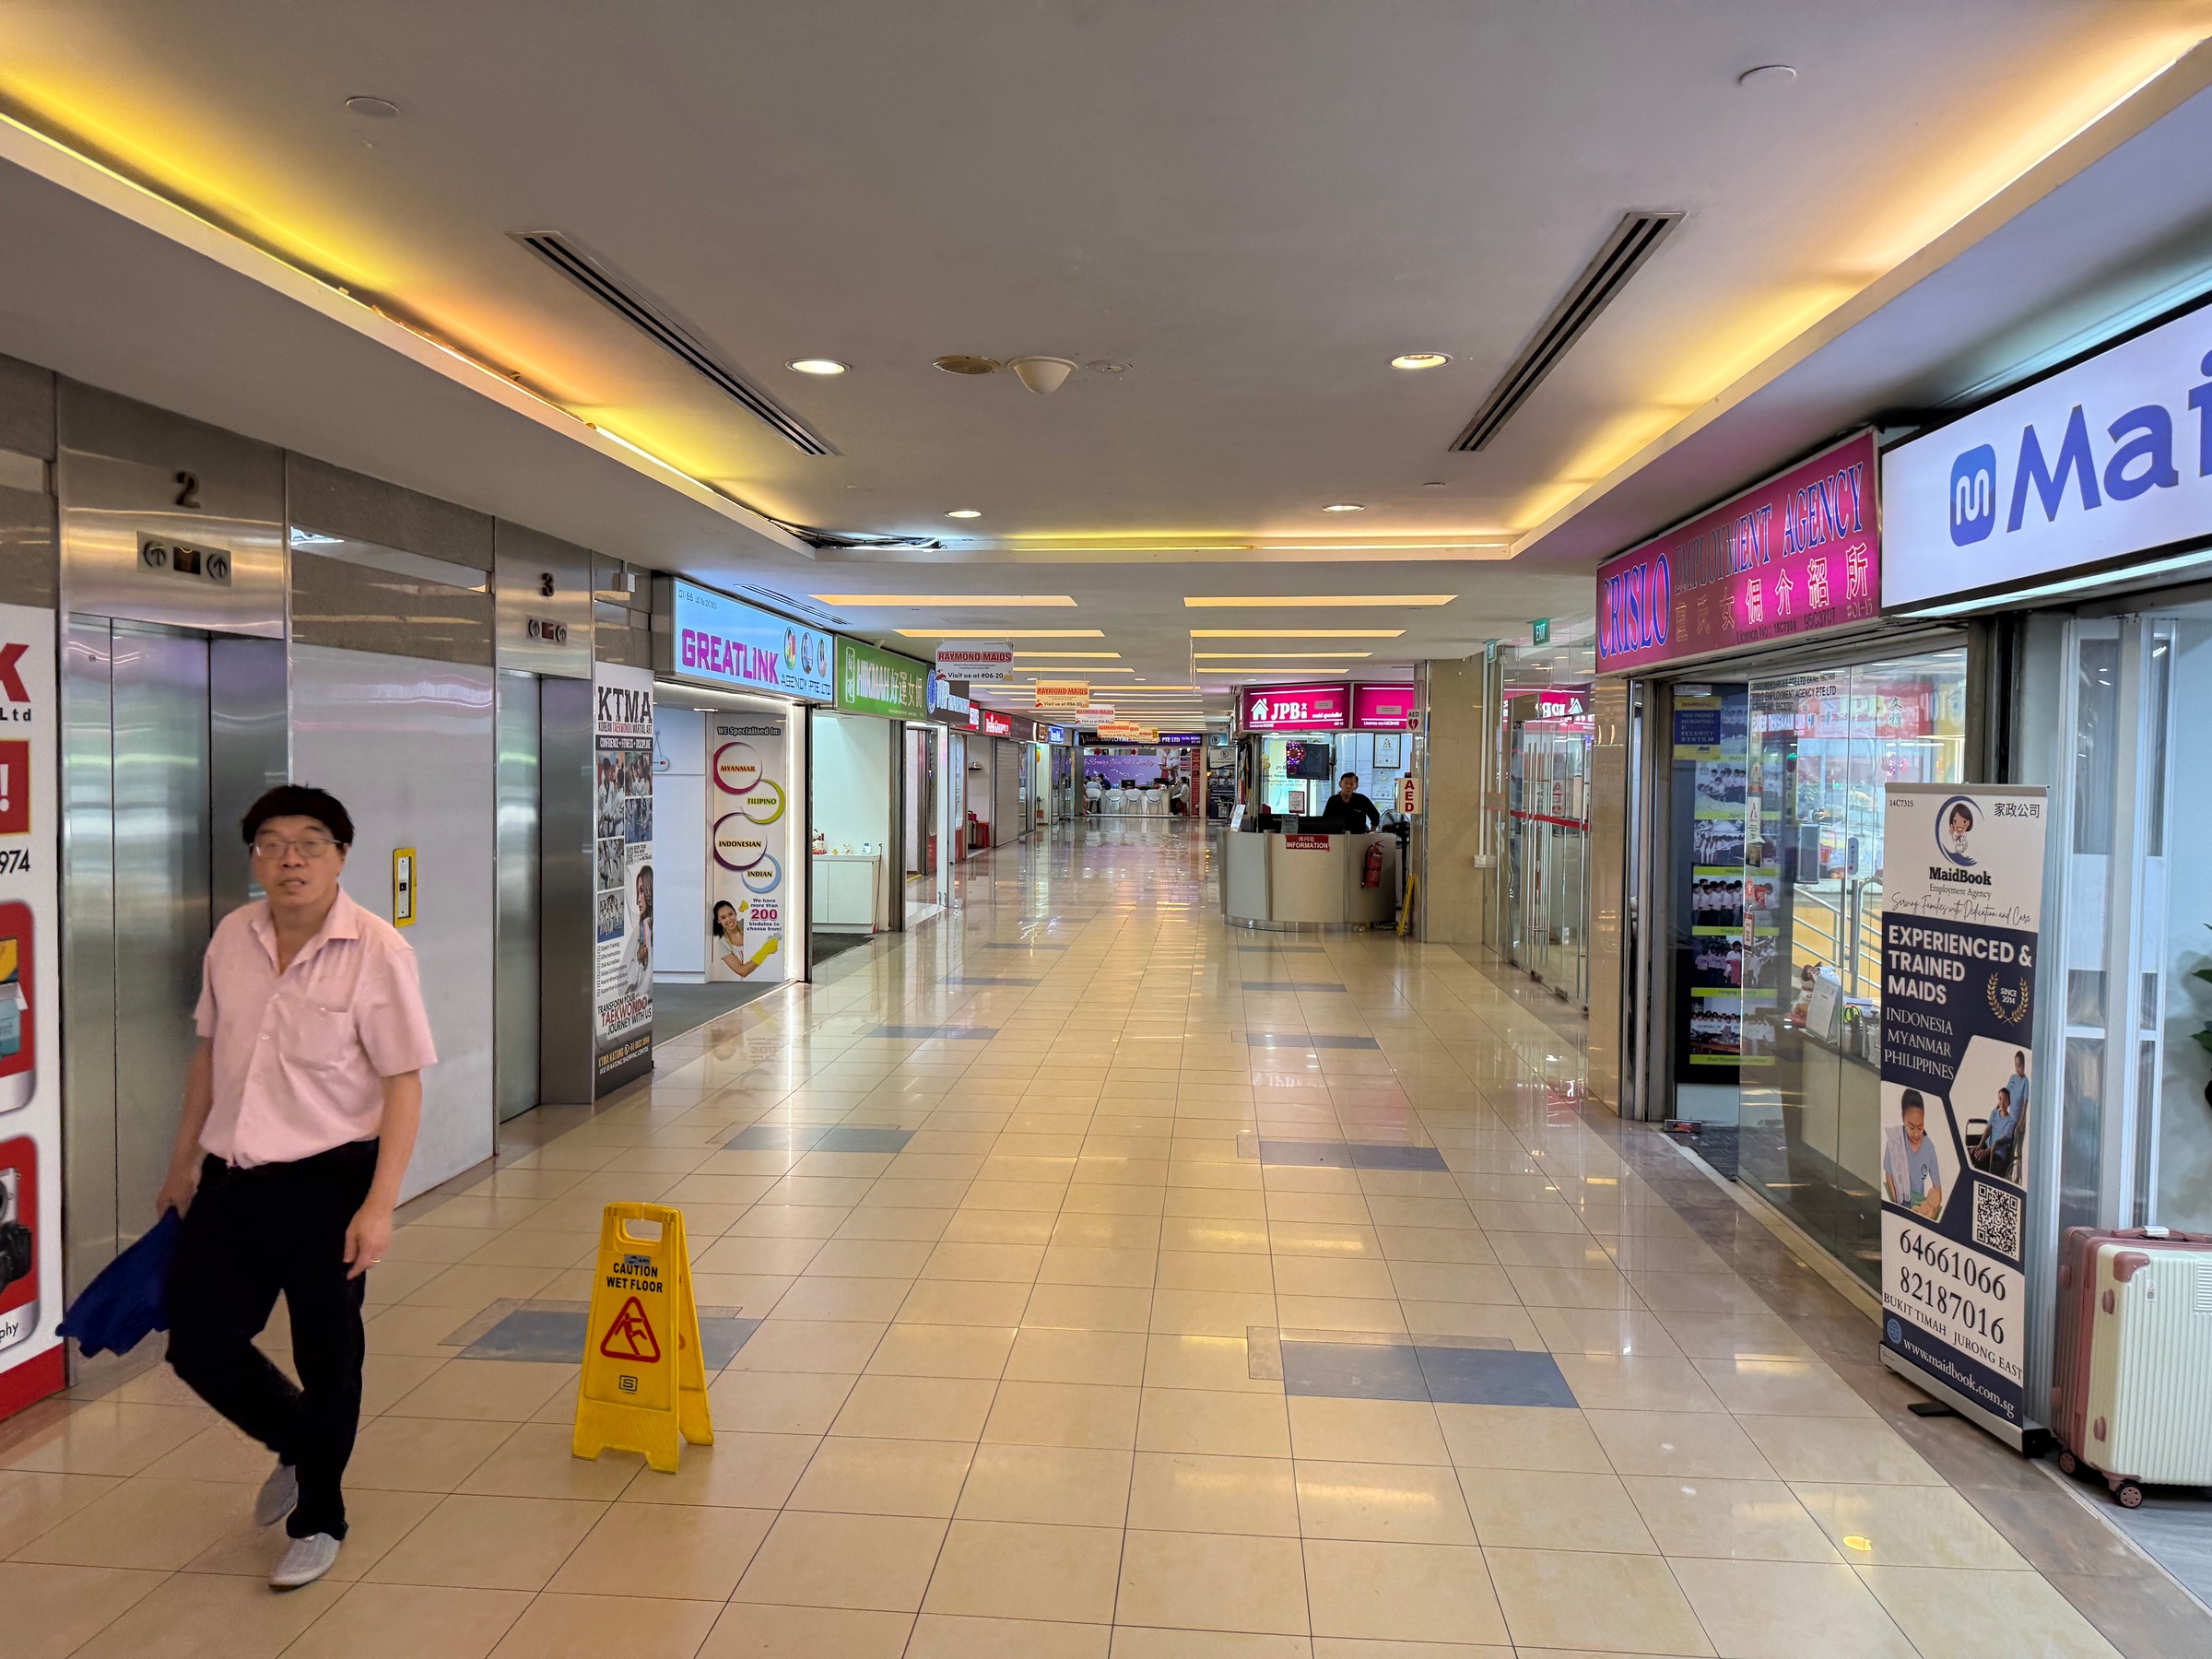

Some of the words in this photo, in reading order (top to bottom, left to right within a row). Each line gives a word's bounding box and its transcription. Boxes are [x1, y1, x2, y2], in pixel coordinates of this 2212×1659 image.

[174, 471, 202, 510] 2
[1598, 552, 1671, 660] CRISLO
[1674, 503, 1771, 596] EMPLOYMENT
[1783, 462, 1864, 558] AGENCY
[540, 572, 555, 597] 3
[682, 628, 780, 685] GREATLINK
[937, 652, 981, 663] RAYMOND
[982, 652, 1012, 663] MAIDS
[781, 674, 807, 690] AGENCY
[808, 680, 820, 693] PTE
[820, 683, 831, 696] LTD
[1795, 688, 1815, 699] AGENCY
[597, 686, 653, 724] KTMA
[1271, 701, 1301, 720] JPB
[600, 737, 618, 747] CONFIDENCE
[636, 739, 651, 749] DISCIPLINE
[717, 726, 728, 735] WE
[729, 726, 770, 736] Specialised
[1404, 780, 1415, 813] AED
[1889, 799, 1914, 807] 14C7315
[1994, 802, 2041, 818] 家政公司
[1929, 866, 1992, 886] MaidBook
[1929, 884, 1966, 897] Employment
[1968, 888, 1992, 900] Agency
[751, 909, 778, 920] 200
[1891, 891, 1920, 911] Serving
[1921, 894, 1947, 915] Families
[1963, 900, 1998, 924] Dedication
[1998, 906, 2012, 925] and
[2012, 906, 2032, 926] Care
[1888, 924, 2016, 963] EXPERIENCED
[2018, 945, 2033, 968] &
[1888, 950, 1966, 982] TRAINED
[597, 997, 624, 1014] TRANSFORM
[624, 993, 636, 1004] YOUR
[1888, 975, 1947, 1005] MAIDS
[2000, 987, 2018, 997] SINCE
[2001, 995, 2017, 1005] 2014
[601, 996, 649, 1028] TAEKWONDO
[607, 1017, 630, 1035] JOURNEY
[631, 1012, 645, 1025] WITH
[645, 1007, 652, 1018] US
[1886, 1006, 1954, 1035] INDONESIA
[1887, 1029, 1951, 1058] MYANMAR
[1884, 1049, 1954, 1080] PHILIPPINES
[613, 1263, 658, 1277] CAUTION
[1900, 1229, 2006, 1300] 64661066
[606, 1277, 629, 1289] WET
[630, 1278, 663, 1293] FLOOR
[1900, 1265, 2005, 1344] 82187016
[1883, 1292, 1913, 1316] BUKIT
[1914, 1308, 1947, 1336] TIMAH
[1953, 1331, 1995, 1364] JURONG
[1998, 1357, 2023, 1381] EAST
[1903, 1338, 2016, 1419] www.maidbook.com.sg
